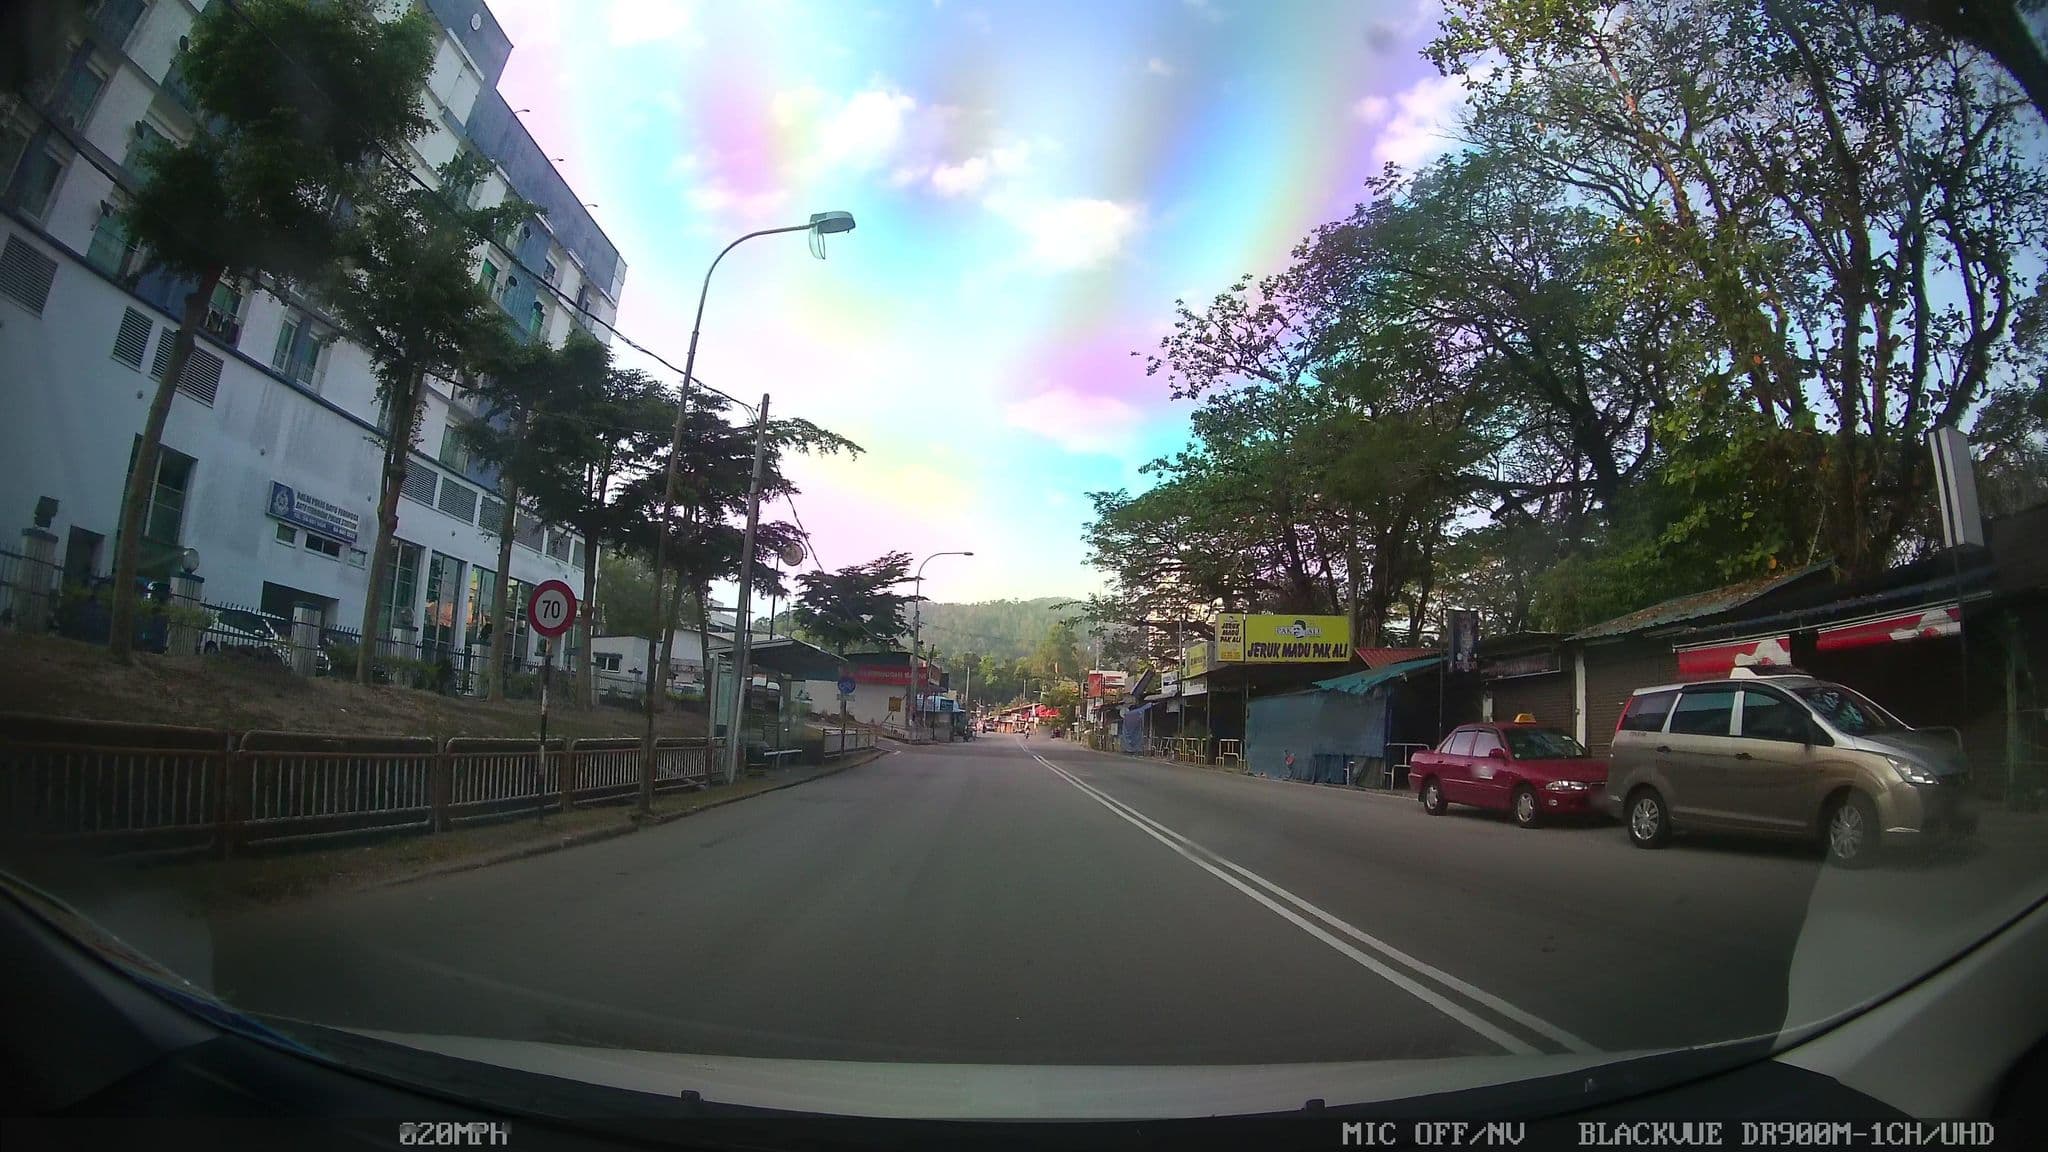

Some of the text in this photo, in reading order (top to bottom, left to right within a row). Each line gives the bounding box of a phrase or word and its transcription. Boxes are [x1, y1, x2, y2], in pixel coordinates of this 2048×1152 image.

[542, 600, 560, 619] 70
[1247, 642, 1280, 658] JERUK
[1281, 643, 1311, 658] MADU
[1312, 643, 1331, 659] PAK
[1332, 643, 1348, 658] ALI
